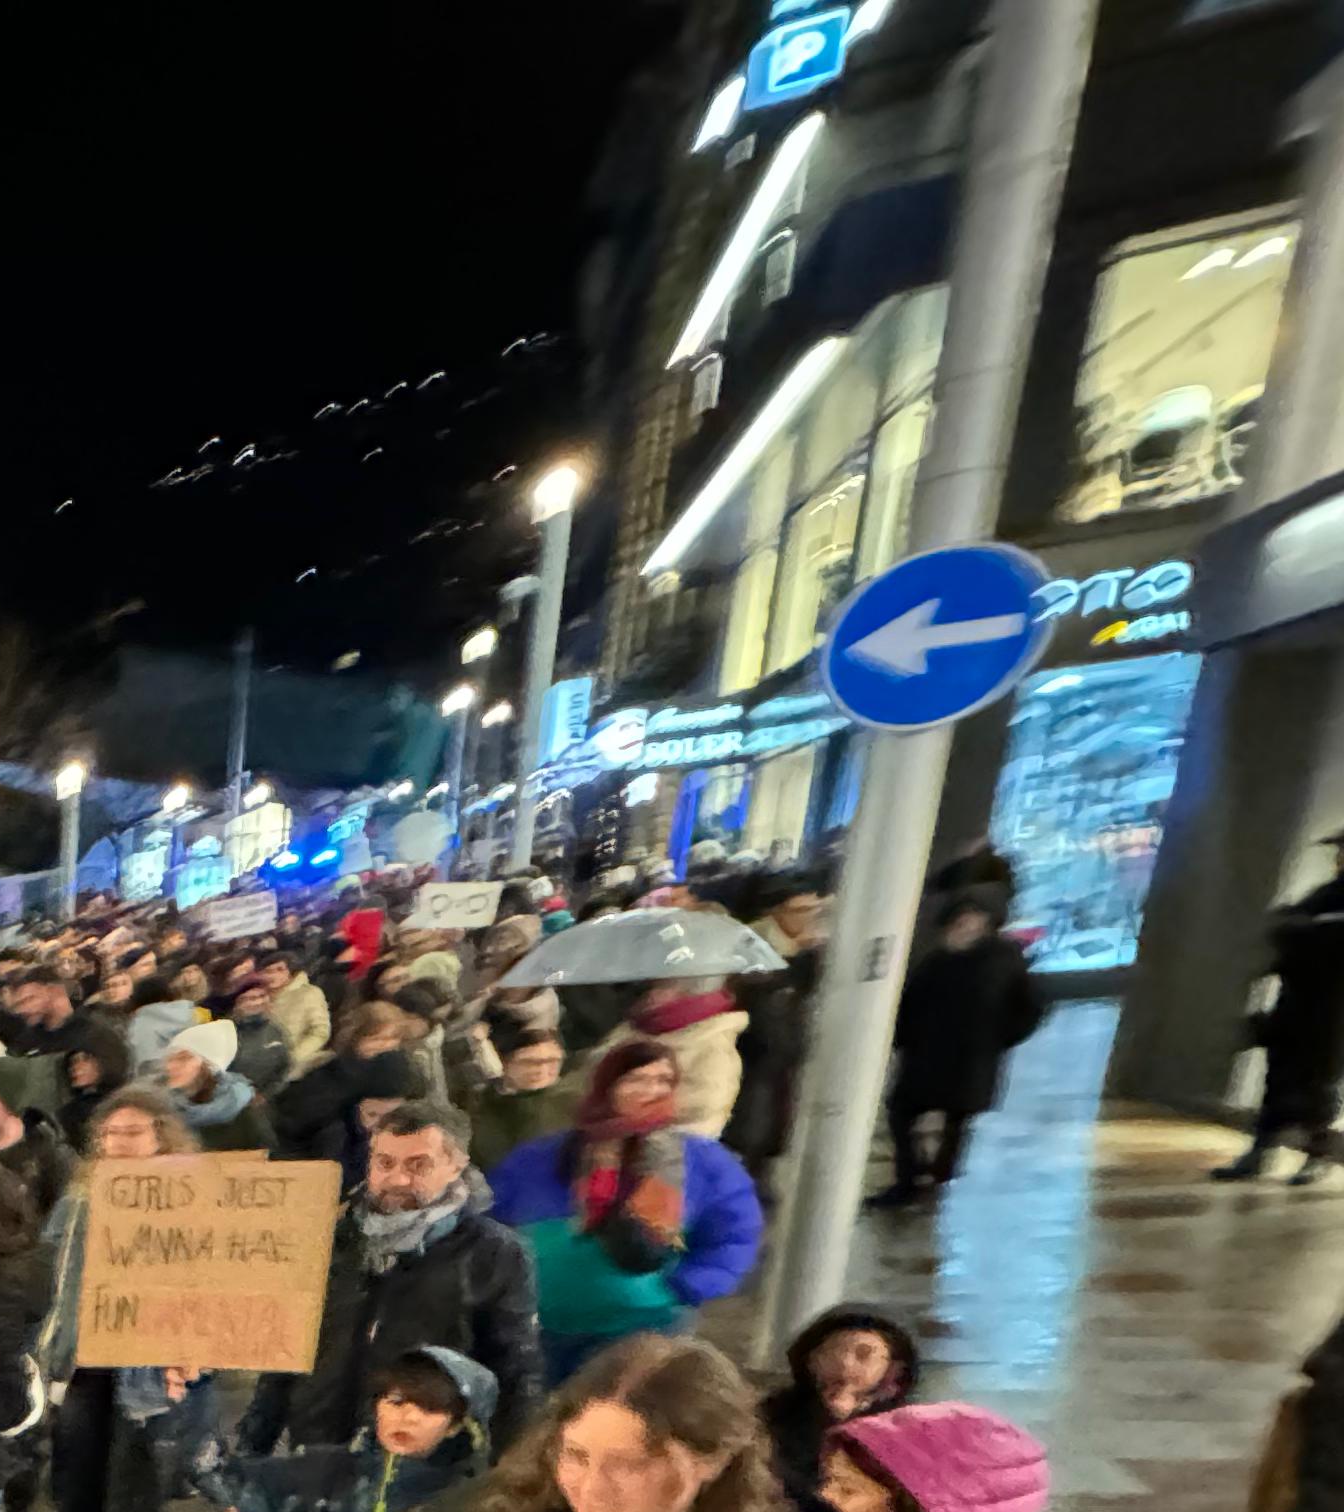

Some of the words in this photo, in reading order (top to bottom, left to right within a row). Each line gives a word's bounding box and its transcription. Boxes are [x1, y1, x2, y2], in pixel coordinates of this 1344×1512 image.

[108, 1174, 196, 1211] GIRLS
[216, 1175, 297, 1209] JUST
[104, 1223, 214, 1268] WANNA
